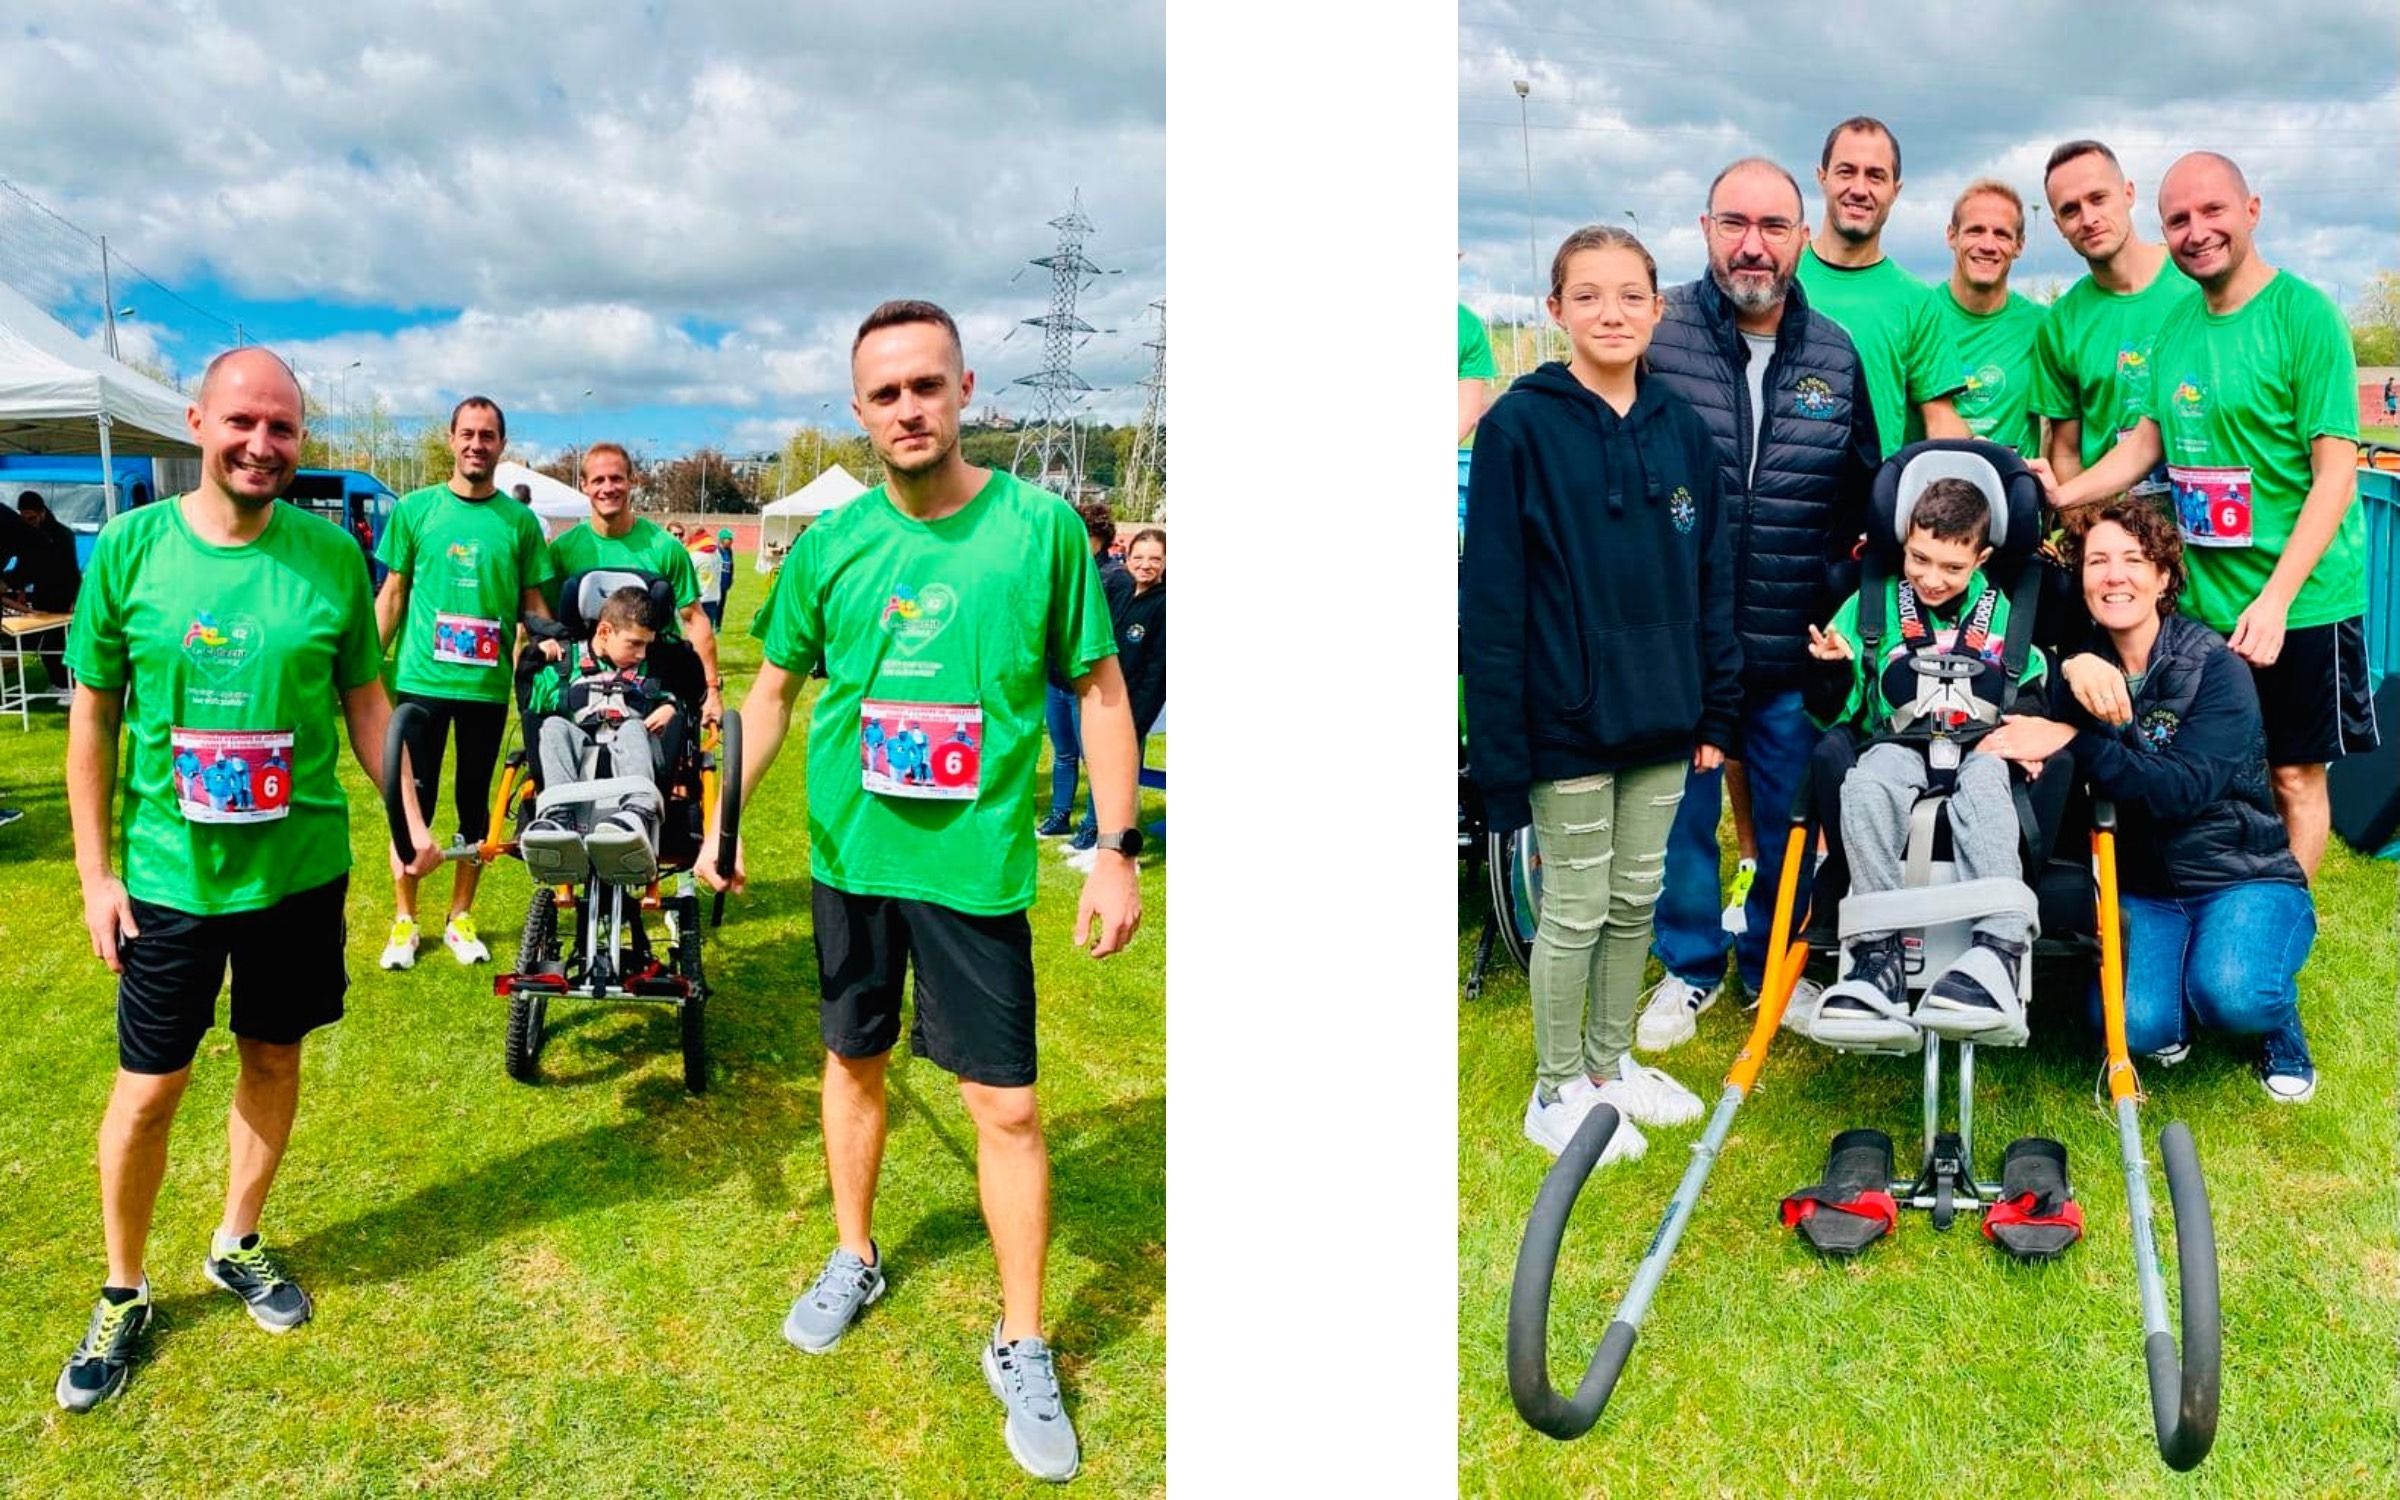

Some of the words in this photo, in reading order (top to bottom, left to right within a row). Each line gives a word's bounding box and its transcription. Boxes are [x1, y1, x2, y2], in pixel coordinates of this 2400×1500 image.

[2222, 507, 2237, 528] 6
[481, 641, 491, 654] 6
[945, 750, 963, 776] 6
[263, 775, 279, 798] 6
